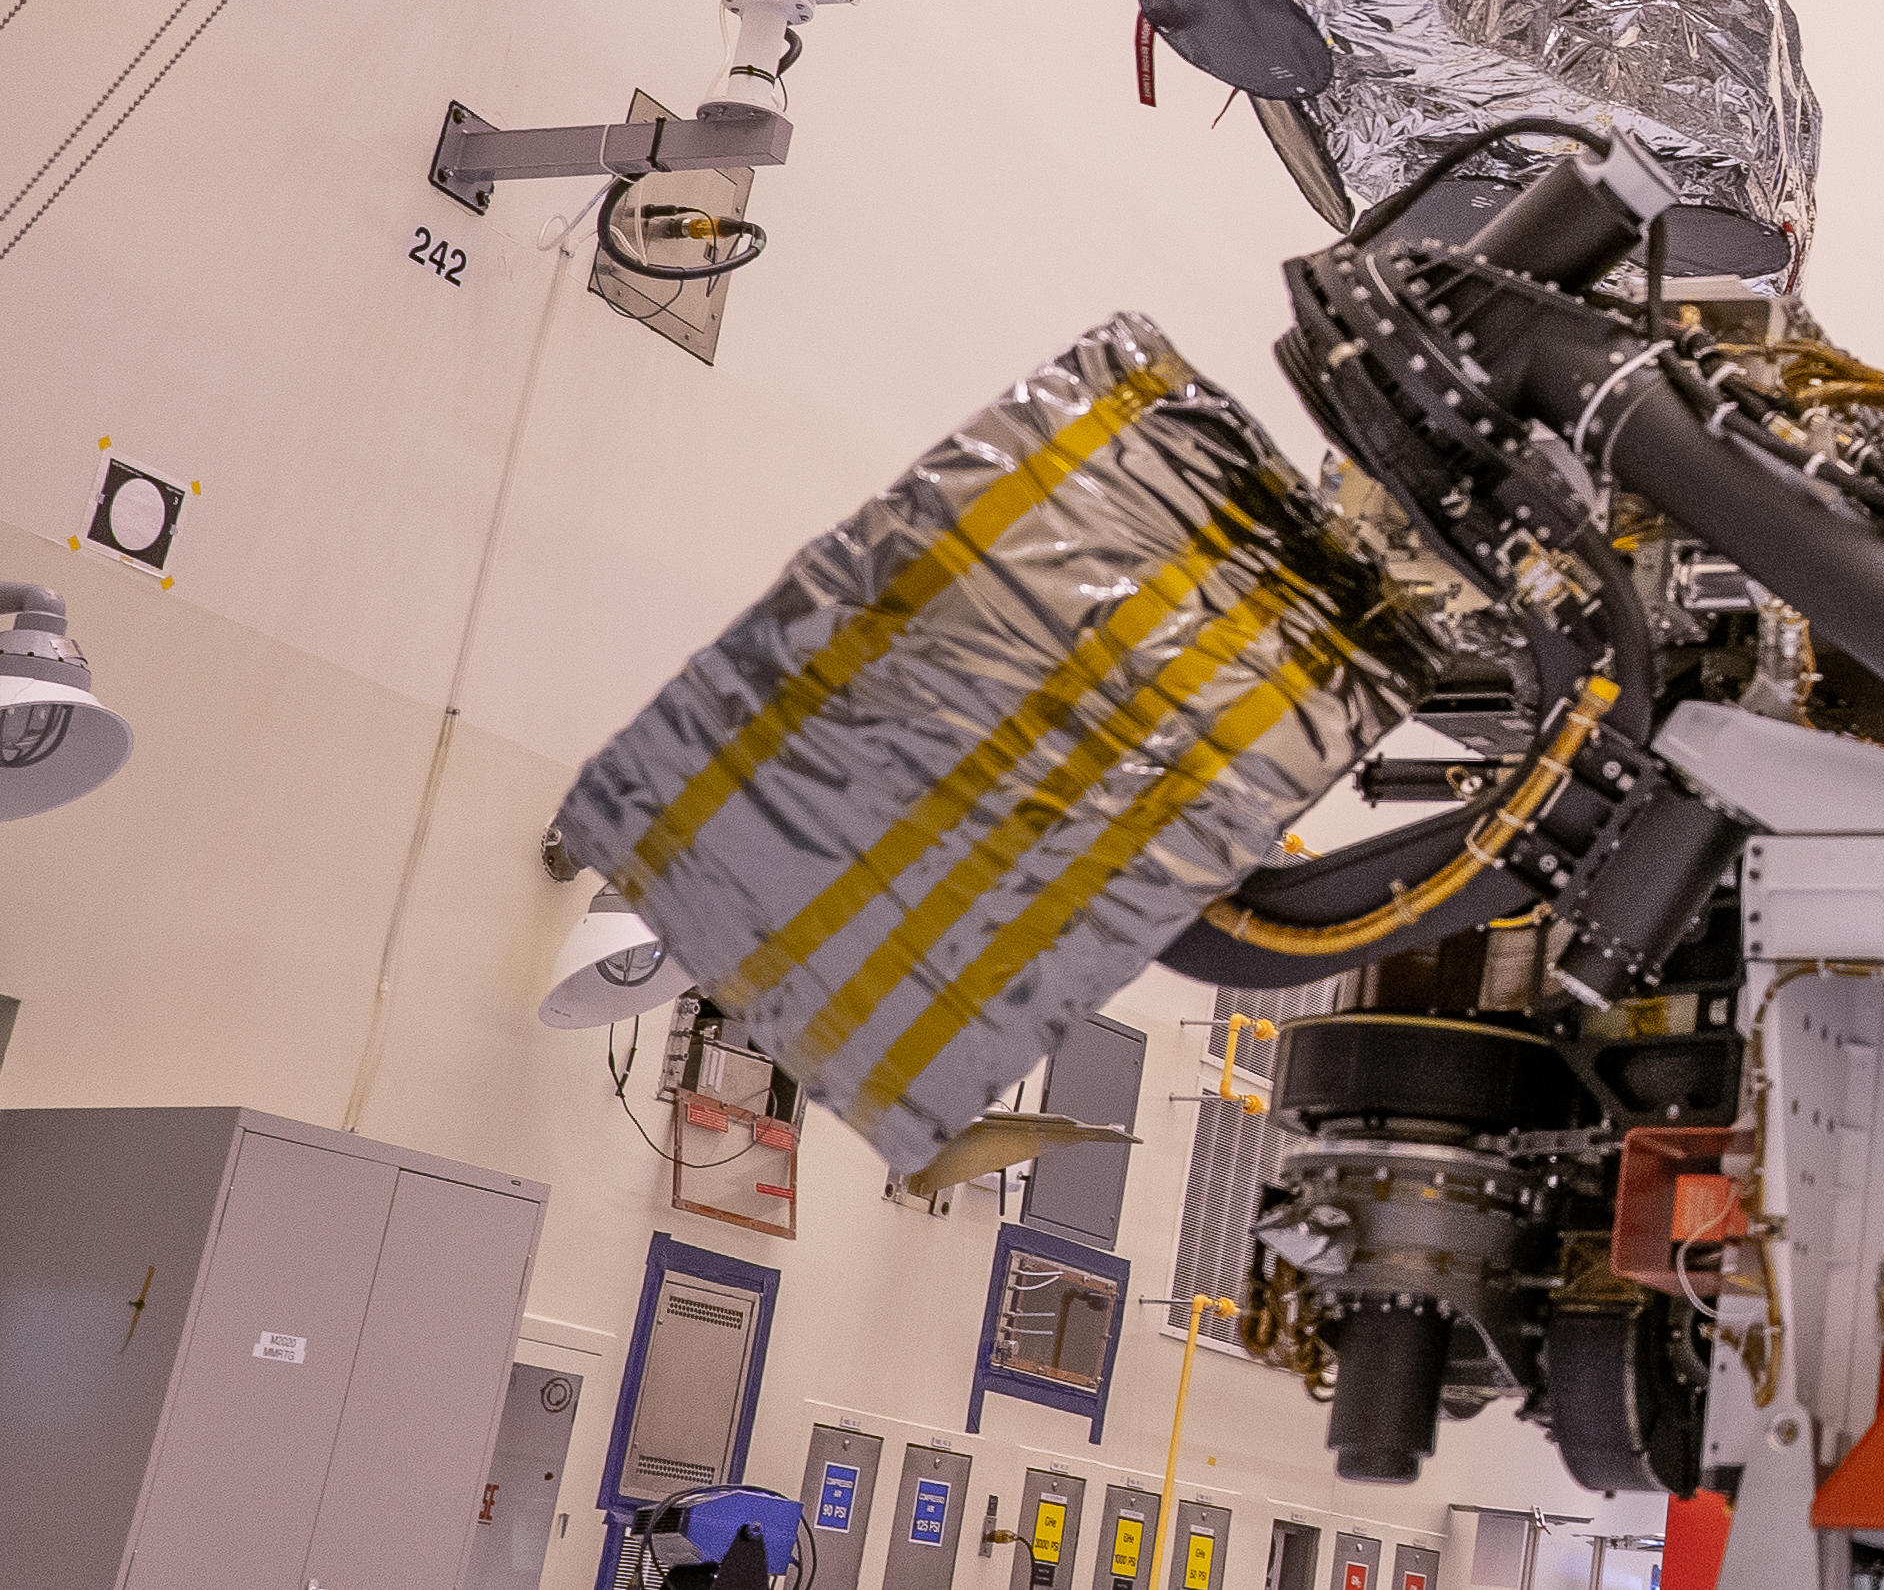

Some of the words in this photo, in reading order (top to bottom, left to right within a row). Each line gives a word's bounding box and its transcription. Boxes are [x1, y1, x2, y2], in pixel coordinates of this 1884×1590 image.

[408, 227, 467, 287] 242
[822, 1504, 833, 1517] 90
[834, 1505, 847, 1519] PSI
[916, 1519, 929, 1532] 125
[929, 1521, 941, 1534] PSI
